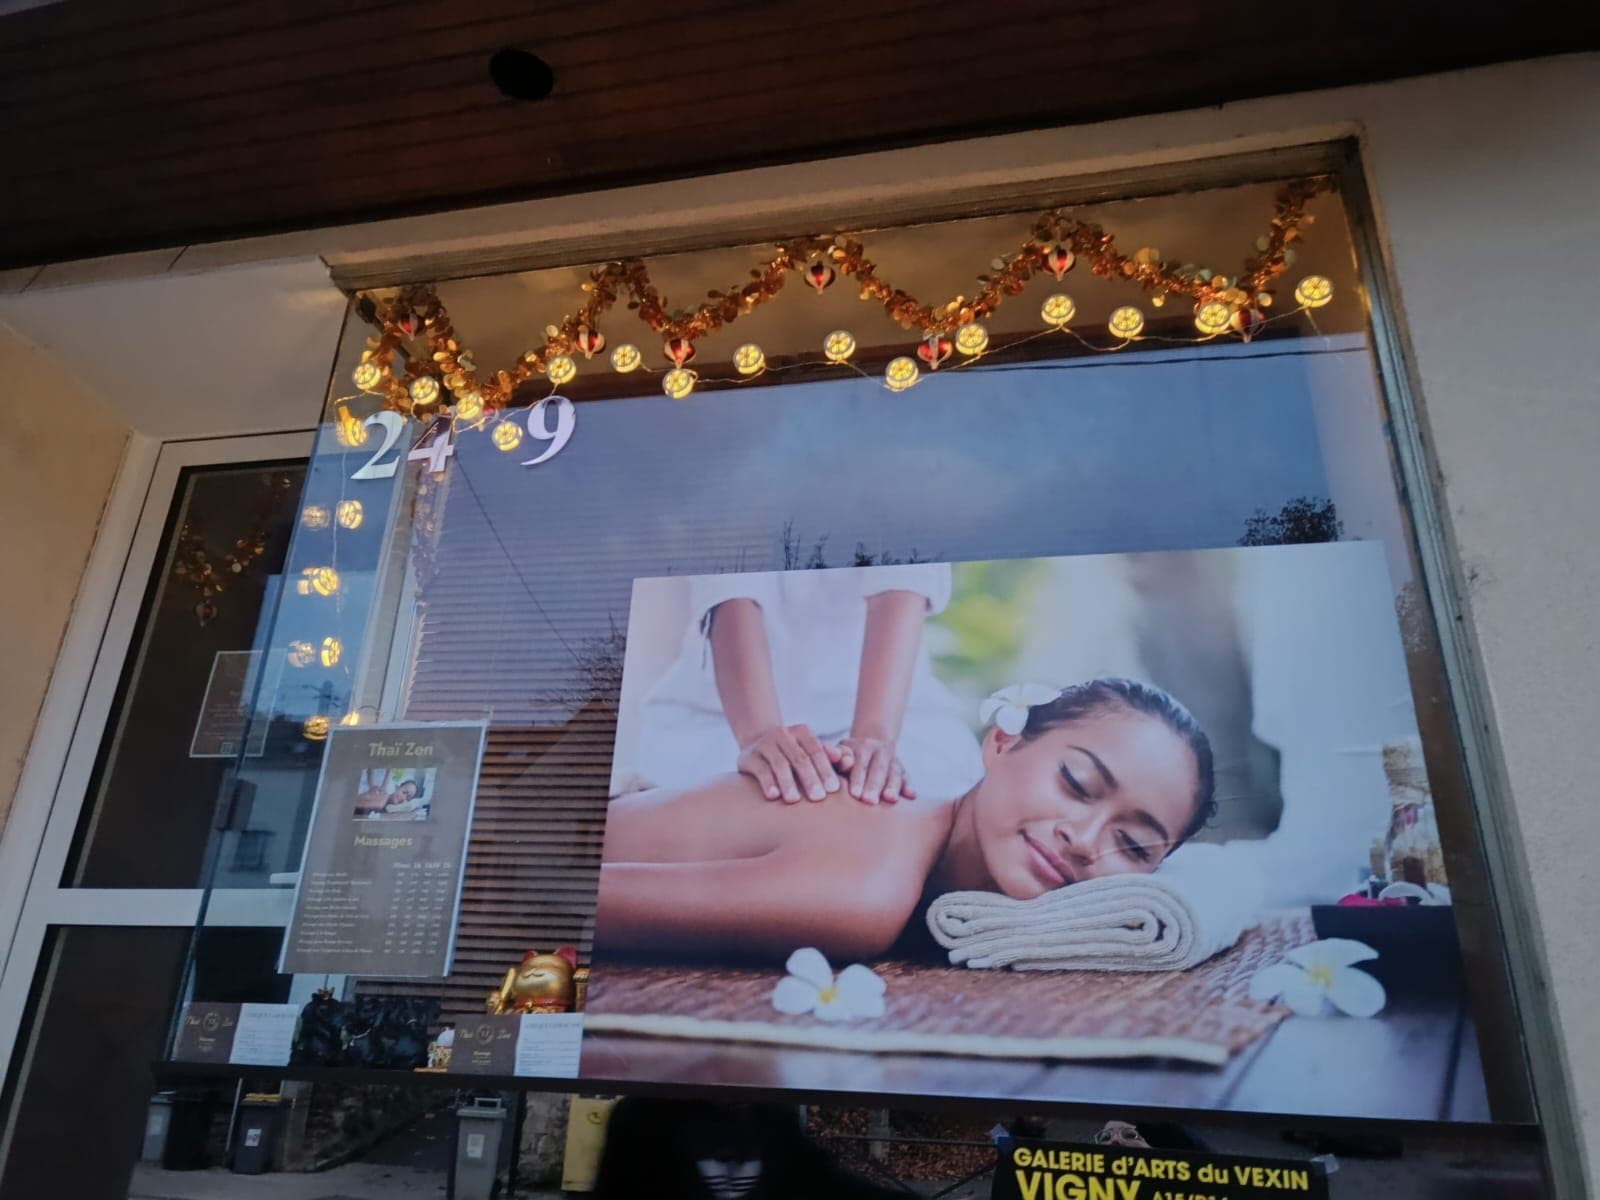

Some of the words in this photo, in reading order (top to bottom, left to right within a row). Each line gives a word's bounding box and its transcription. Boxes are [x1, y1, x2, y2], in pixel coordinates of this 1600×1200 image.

[353, 835, 414, 850] Massages
[1013, 1147, 1105, 1173] GALERIE
[1111, 1156, 1191, 1182] d'ARTS
[1197, 1164, 1229, 1184] du
[1233, 1166, 1309, 1191] VEXIN
[1015, 1169, 1141, 1200] VIGNY
